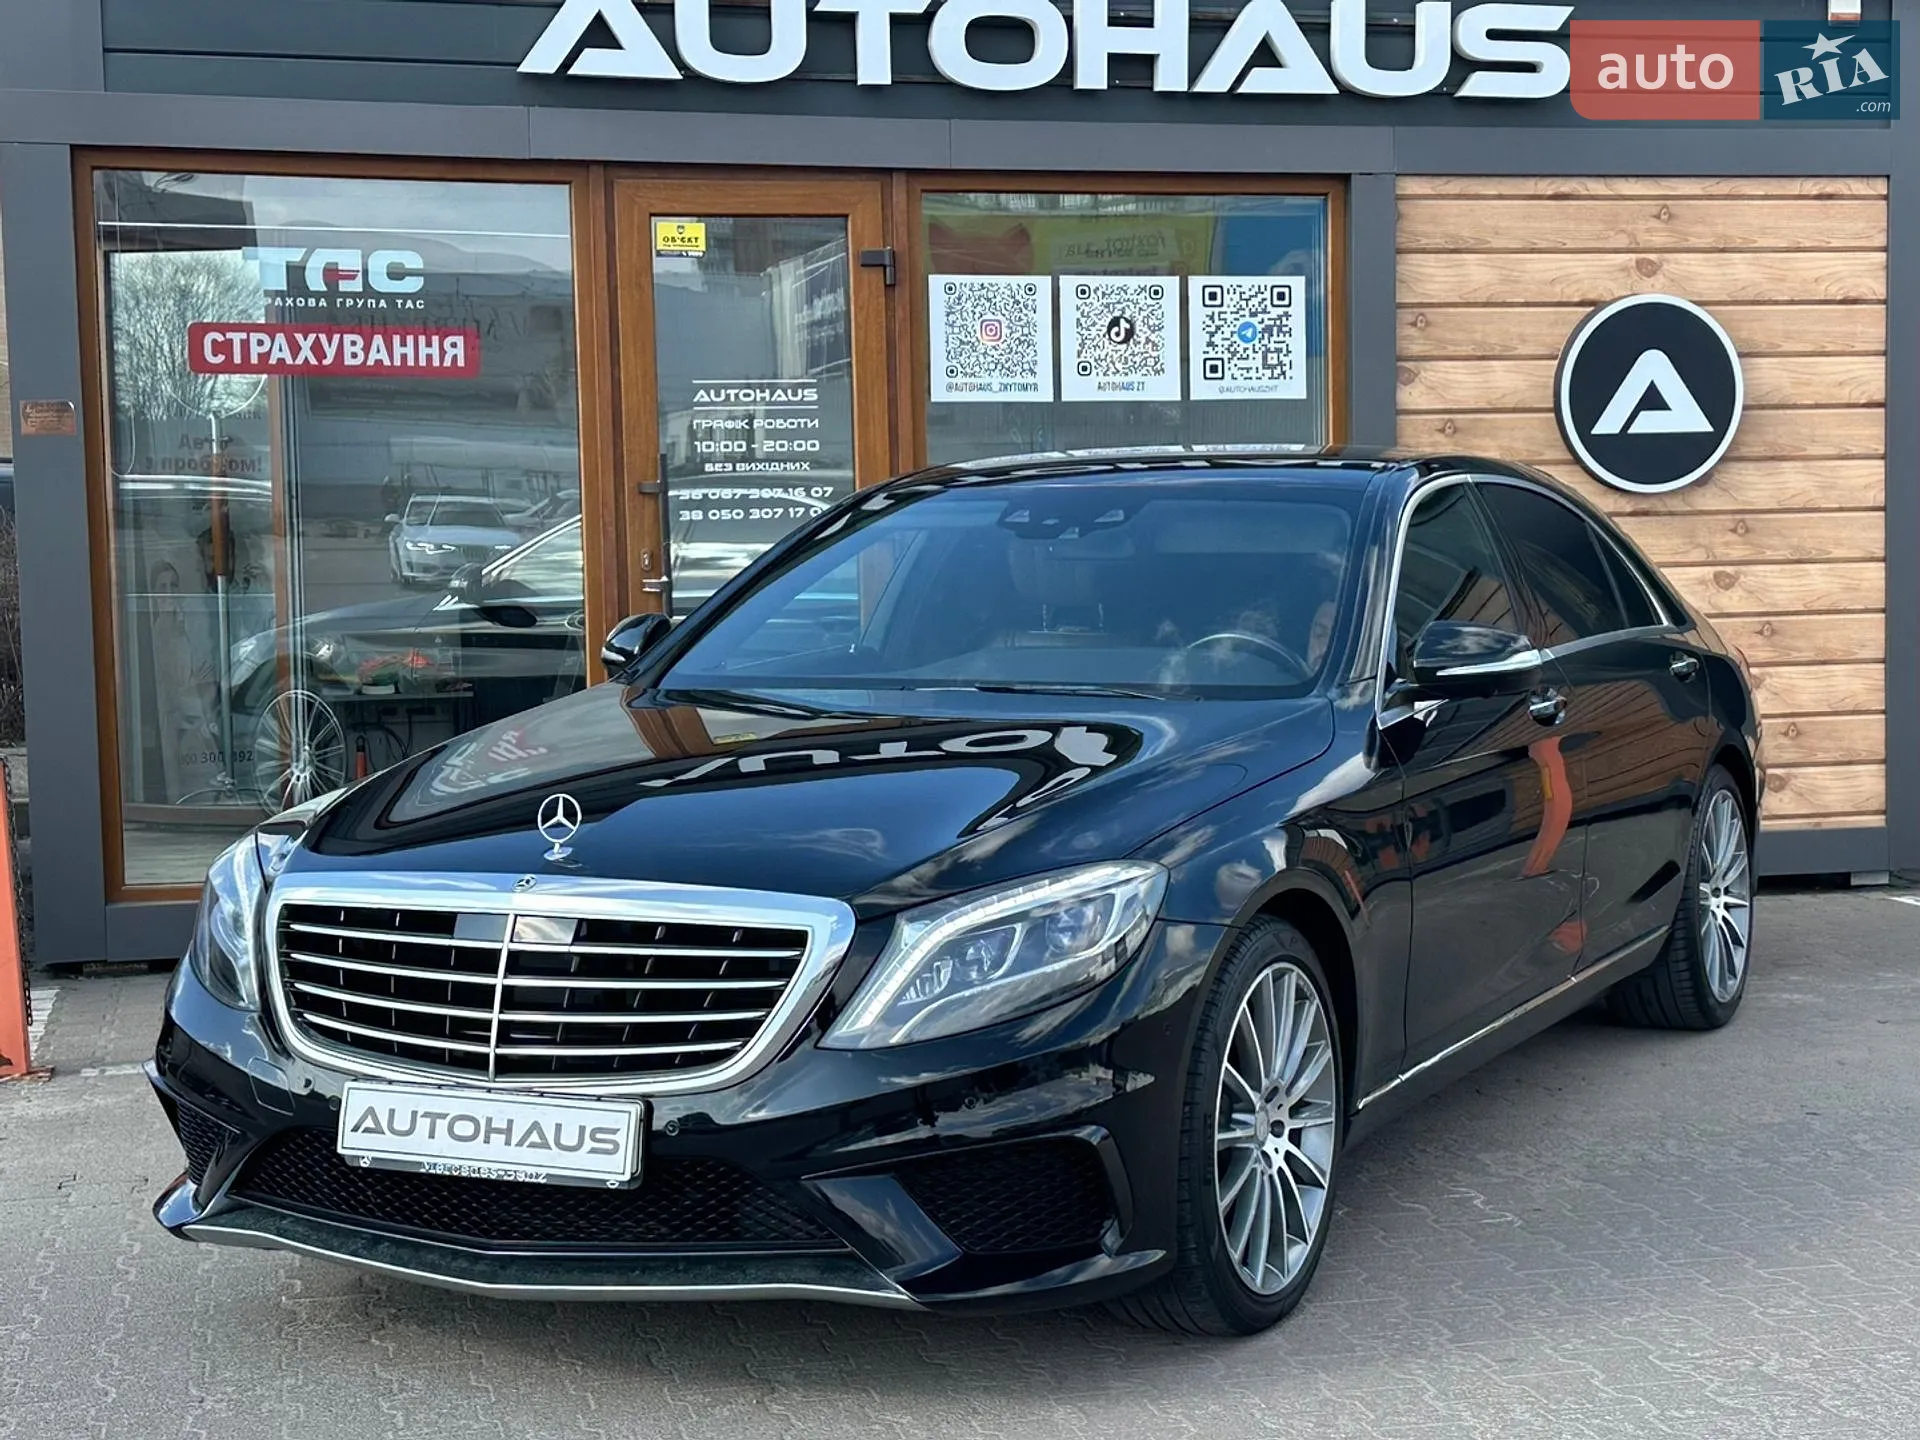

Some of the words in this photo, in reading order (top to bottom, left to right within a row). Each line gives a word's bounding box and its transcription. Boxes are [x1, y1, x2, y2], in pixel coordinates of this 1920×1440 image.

[516, 0, 1575, 98] AUTOHAUS
[336, 299, 387, 309] ГРУПА
[396, 300, 424, 309] ТАС
[203, 331, 466, 367] СТРАХУВАННЯ
[693, 389, 818, 402] AUTOHAUS
[693, 419, 750, 430] ГРАФІК
[753, 418, 819, 429] РОБОТИ
[694, 440, 747, 452] 10:00
[763, 440, 820, 452] 20:00
[704, 462, 733, 472] БЕЗ
[735, 461, 811, 472] ВИХІДНИХ
[810, 486, 834, 497] 07
[679, 510, 703, 521] 38
[708, 509, 744, 520] 050
[749, 508, 784, 519] 307
[788, 507, 805, 518] 17
[350, 1106, 621, 1155] AUTOHAUS
